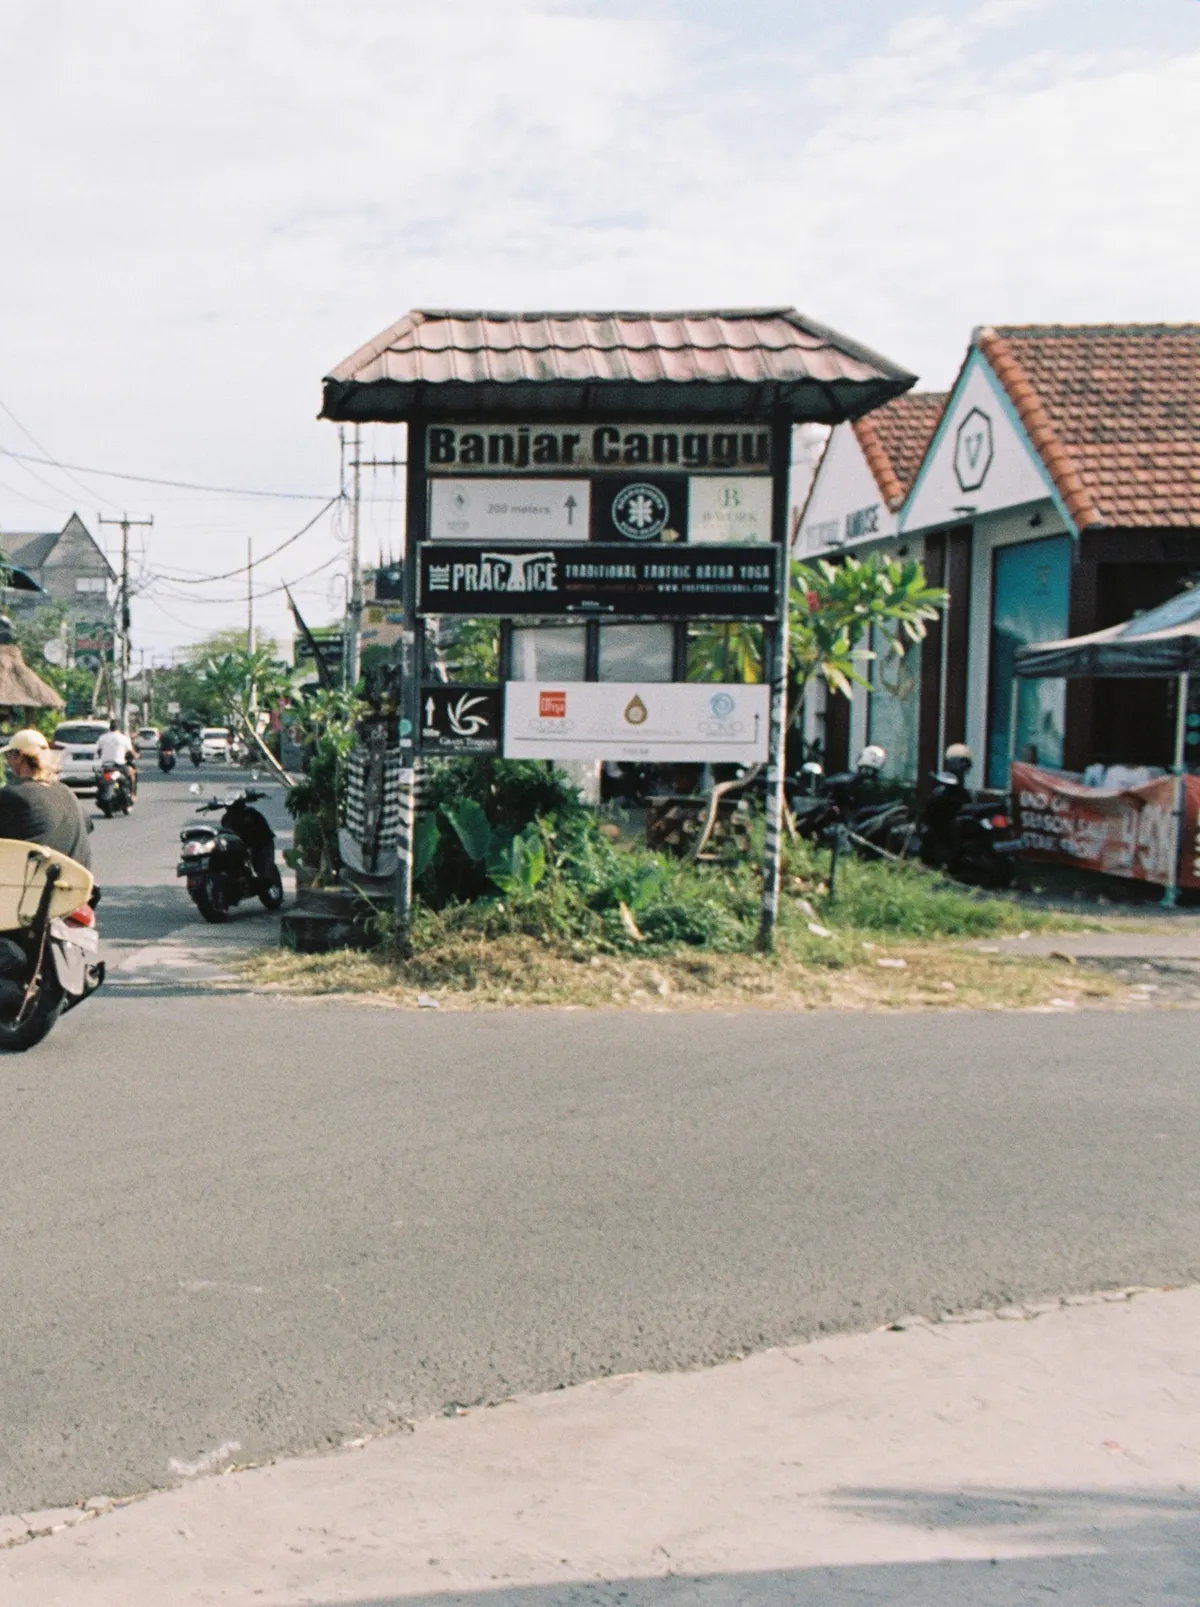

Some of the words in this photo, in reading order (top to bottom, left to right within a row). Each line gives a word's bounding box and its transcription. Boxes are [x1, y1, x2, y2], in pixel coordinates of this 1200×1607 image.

[429, 427, 580, 468] Banjar
[593, 427, 768, 468] Canggu
[510, 503, 551, 515] meters
[428, 563, 451, 592] THE
[452, 551, 559, 592] PRACTICE
[565, 564, 637, 579] TRADITIONAL
[740, 564, 771, 579] YOGA
